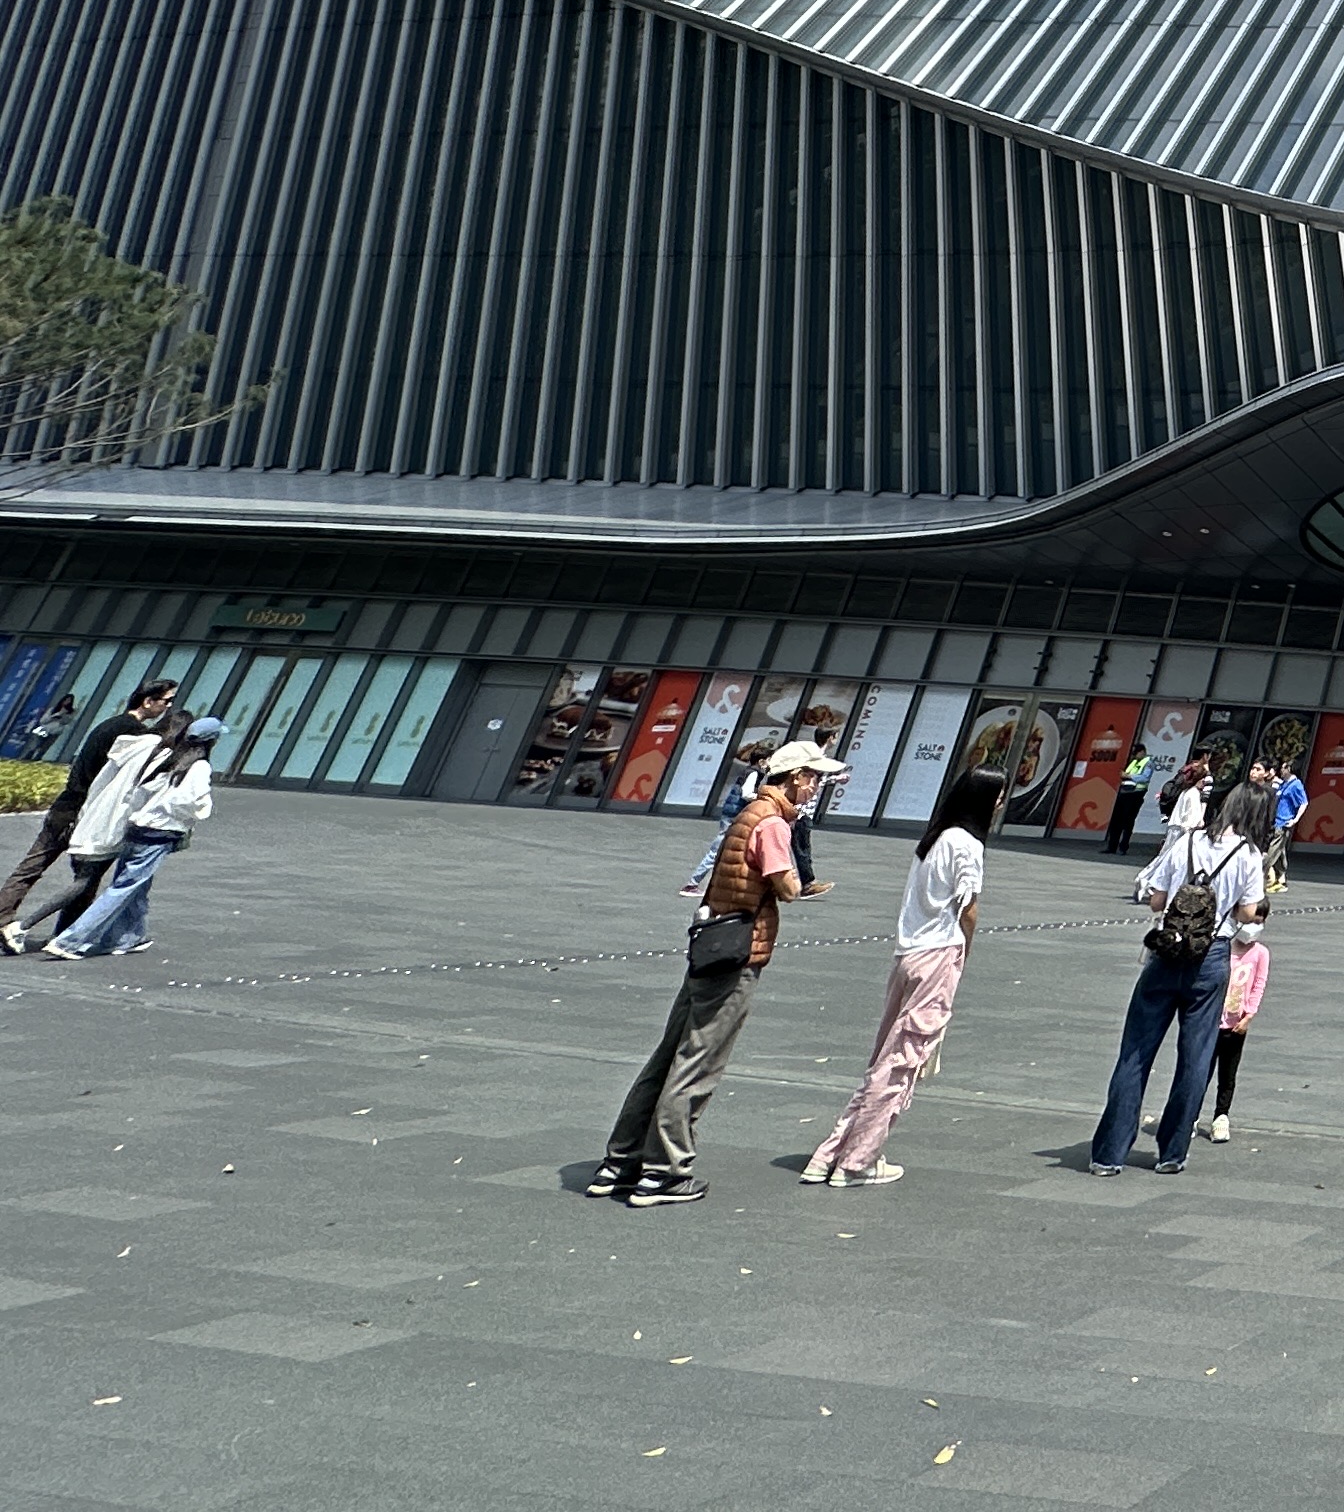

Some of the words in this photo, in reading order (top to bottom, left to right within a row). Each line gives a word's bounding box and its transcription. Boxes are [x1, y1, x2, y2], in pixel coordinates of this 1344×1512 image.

[851, 684, 881, 751] COMING
[914, 751, 944, 761] STONE
[917, 743, 938, 752] SALT
[829, 765, 854, 811] SON
